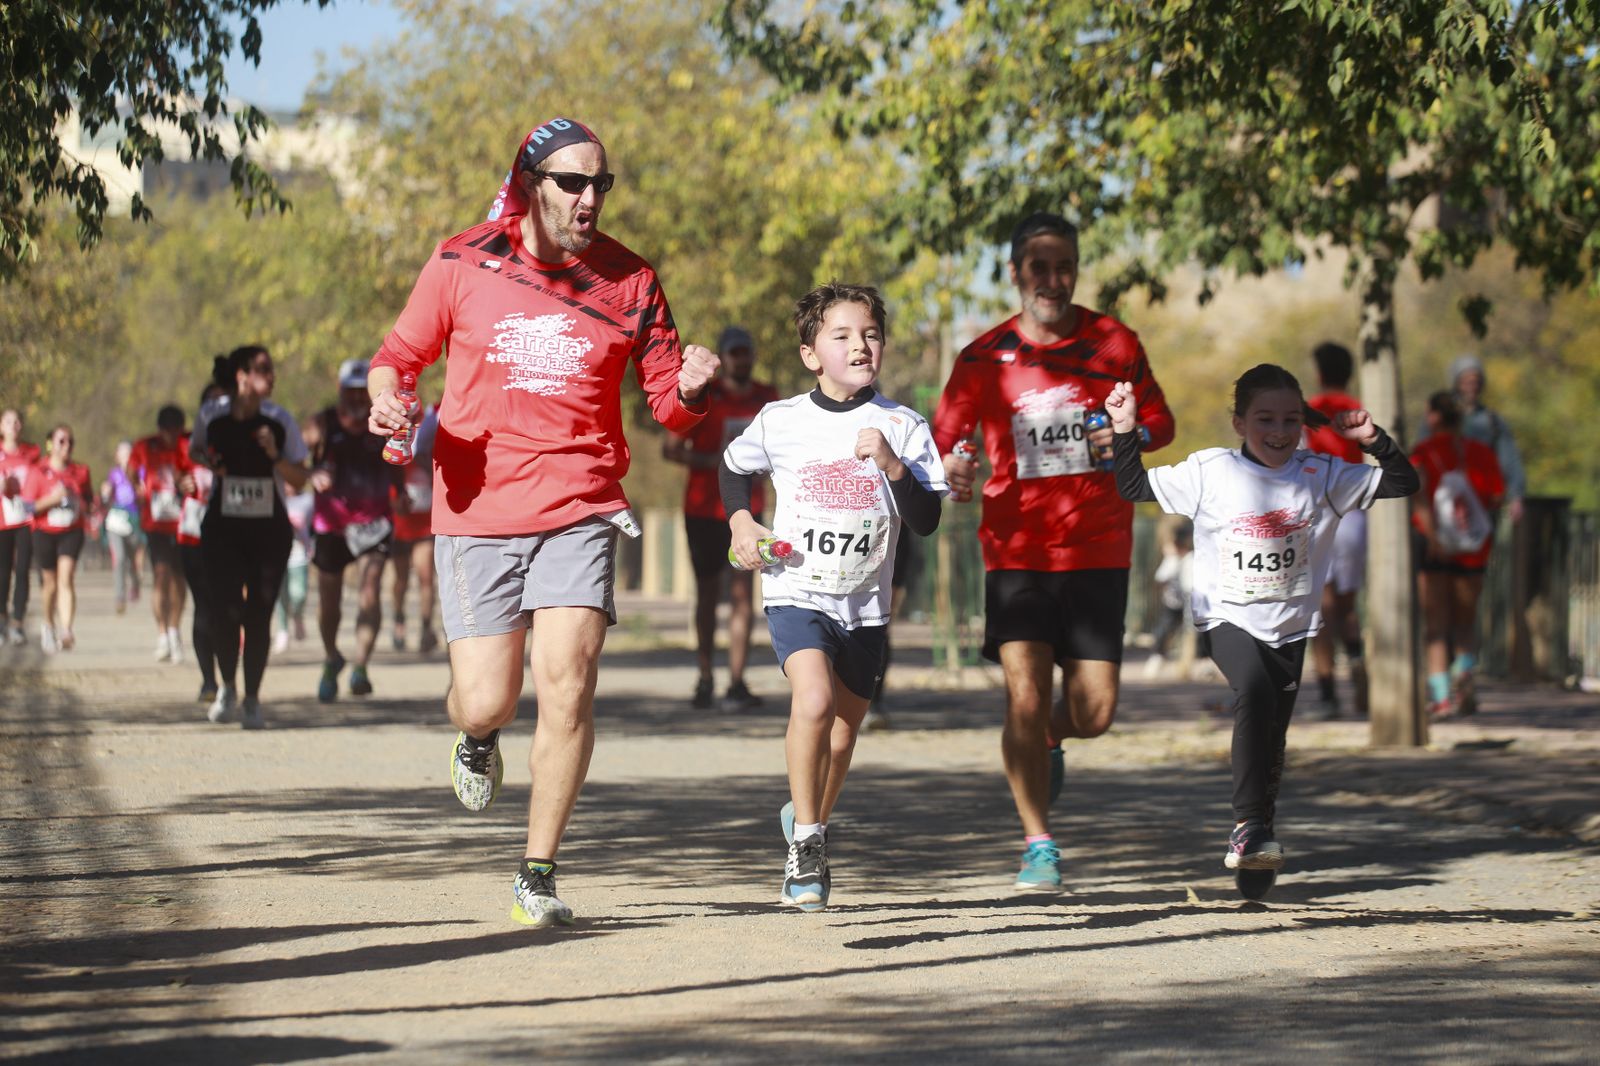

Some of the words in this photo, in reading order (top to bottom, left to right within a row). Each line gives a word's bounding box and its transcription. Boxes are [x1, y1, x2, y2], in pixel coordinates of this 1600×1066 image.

[526, 118, 572, 155] ING
[1027, 423, 1084, 446] 1440
[802, 477, 875, 493] carrera
[804, 493, 875, 507] cruzroja.es
[803, 528, 870, 556] 1674
[1233, 548, 1295, 572] 1439
